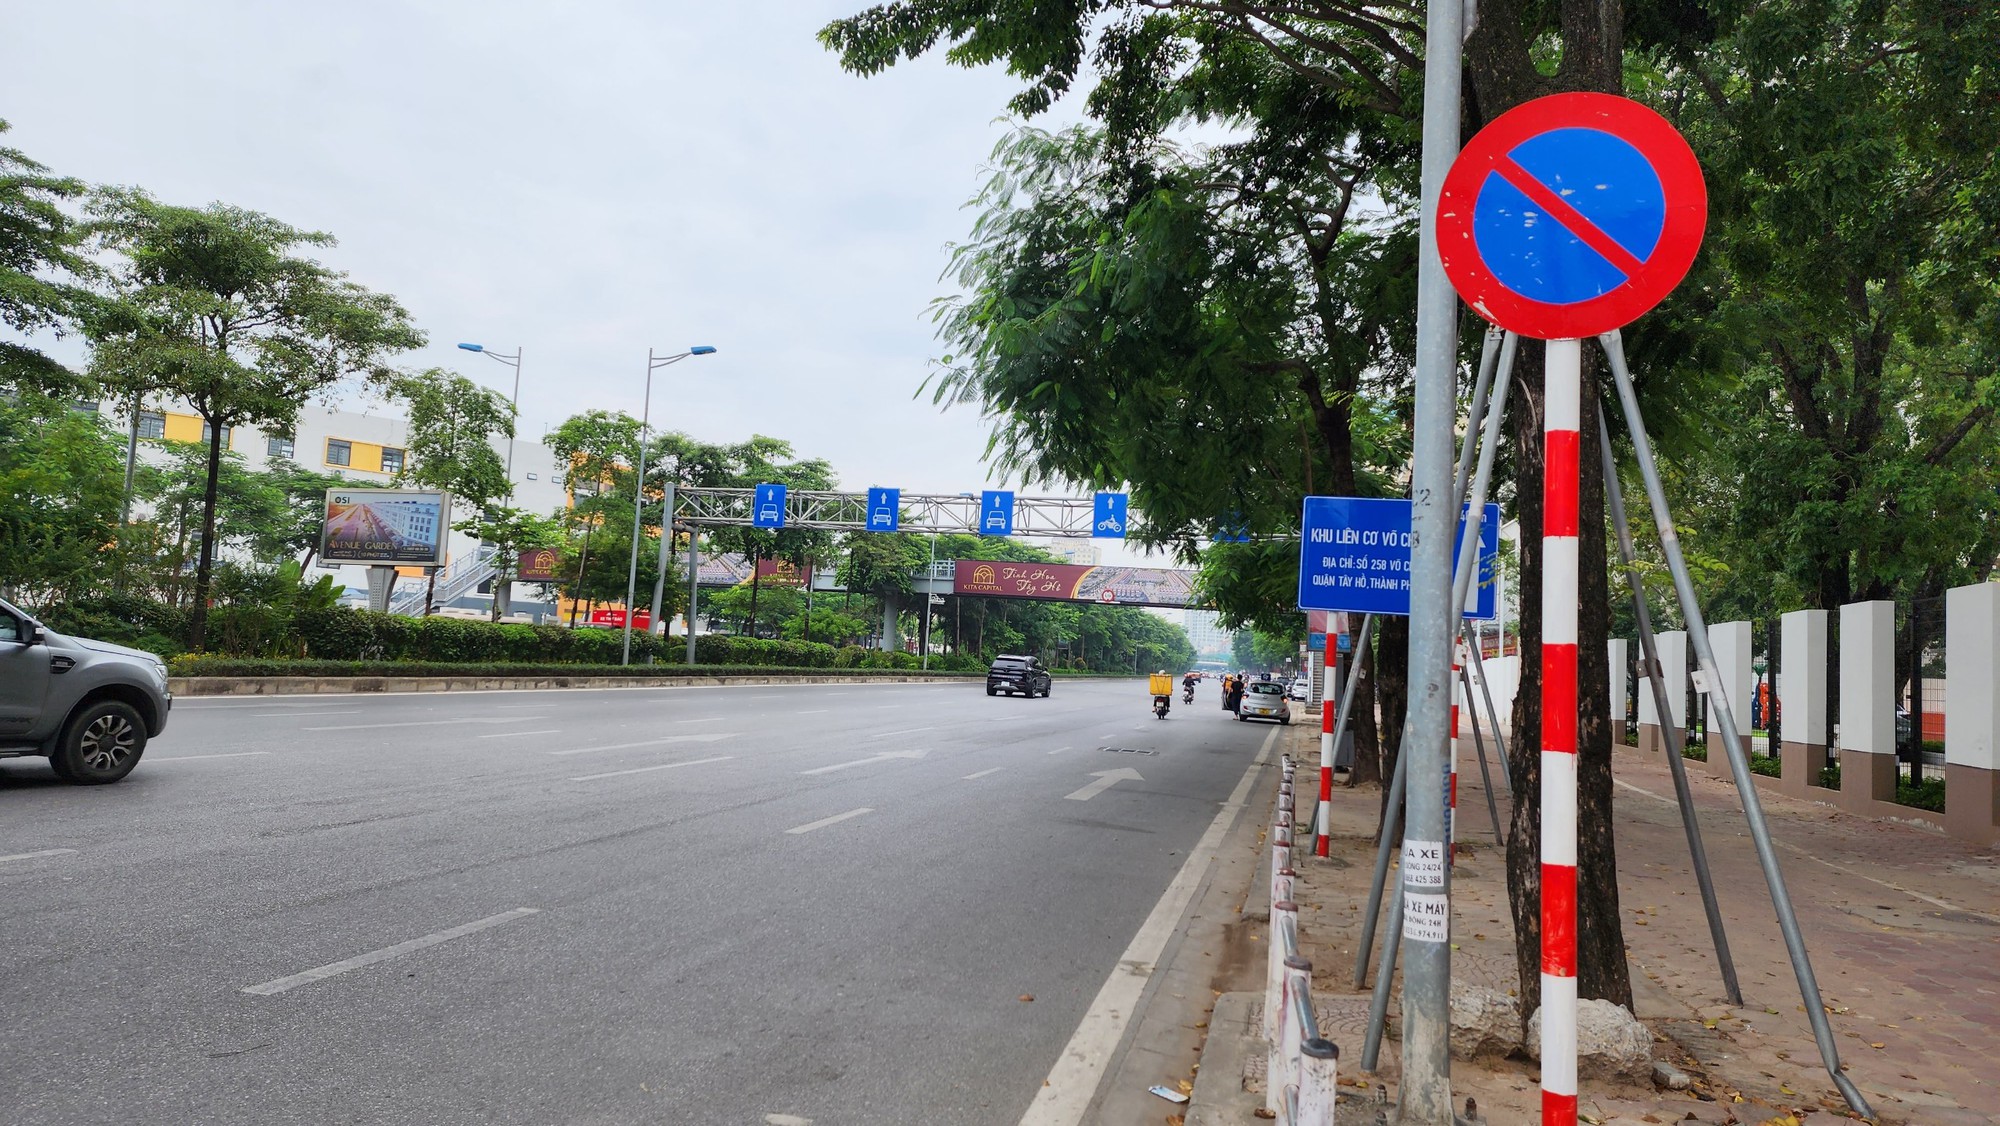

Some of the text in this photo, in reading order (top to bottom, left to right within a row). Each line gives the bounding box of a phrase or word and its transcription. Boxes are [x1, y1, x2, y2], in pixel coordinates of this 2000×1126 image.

[335, 496, 350, 504] OSI
[1311, 528, 1333, 543] KHU
[1336, 527, 1359, 545] LIÊN
[1363, 531, 1379, 546] CƠ
[1382, 529, 1398, 547] VÕ
[329, 541, 361, 550] AVENUE
[365, 541, 397, 550] GARDEN
[1322, 556, 1337, 570] ĐỊA
[1371, 560, 1387, 571] 258
[1390, 559, 1401, 571] VÕ
[1002, 567, 1056, 580] Tinh Hoa
[1312, 573, 1335, 588] QUẬN
[1338, 575, 1353, 588] TÂY
[1420, 848, 1439, 859] XE
[1415, 875, 1427, 884] 425
[1411, 900, 1422, 913] XE
[1425, 900, 1446, 915] MÁY
[1429, 919, 1442, 927] 24H
